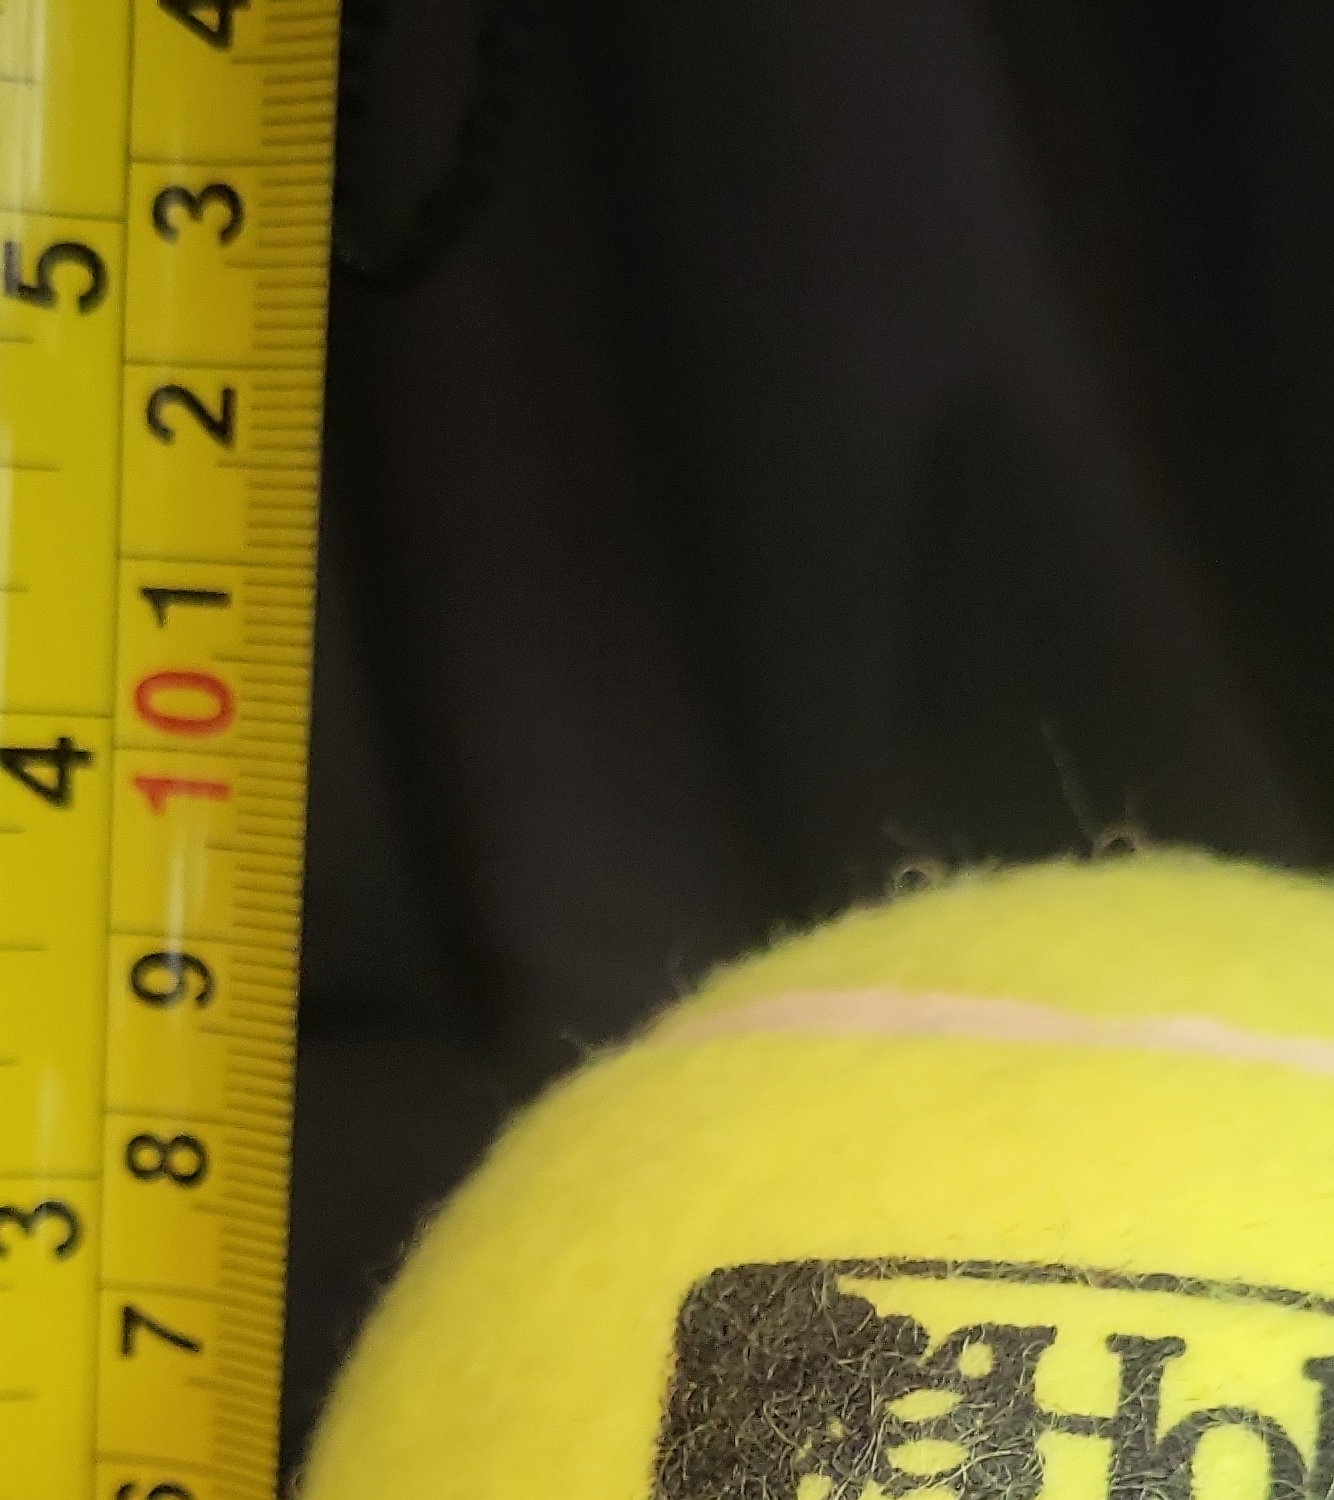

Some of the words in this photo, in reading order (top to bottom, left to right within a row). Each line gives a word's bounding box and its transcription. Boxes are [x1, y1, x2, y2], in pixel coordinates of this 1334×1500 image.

[158, 0, 251, 51] 4
[151, 183, 244, 245] 3
[2, 240, 108, 315] 5
[145, 383, 237, 448] 2
[140, 586, 232, 628] 1
[133, 670, 236, 815] 10
[130, 951, 213, 1010] 9
[125, 1133, 208, 1187] 8
[119, 1305, 202, 1358] 7
